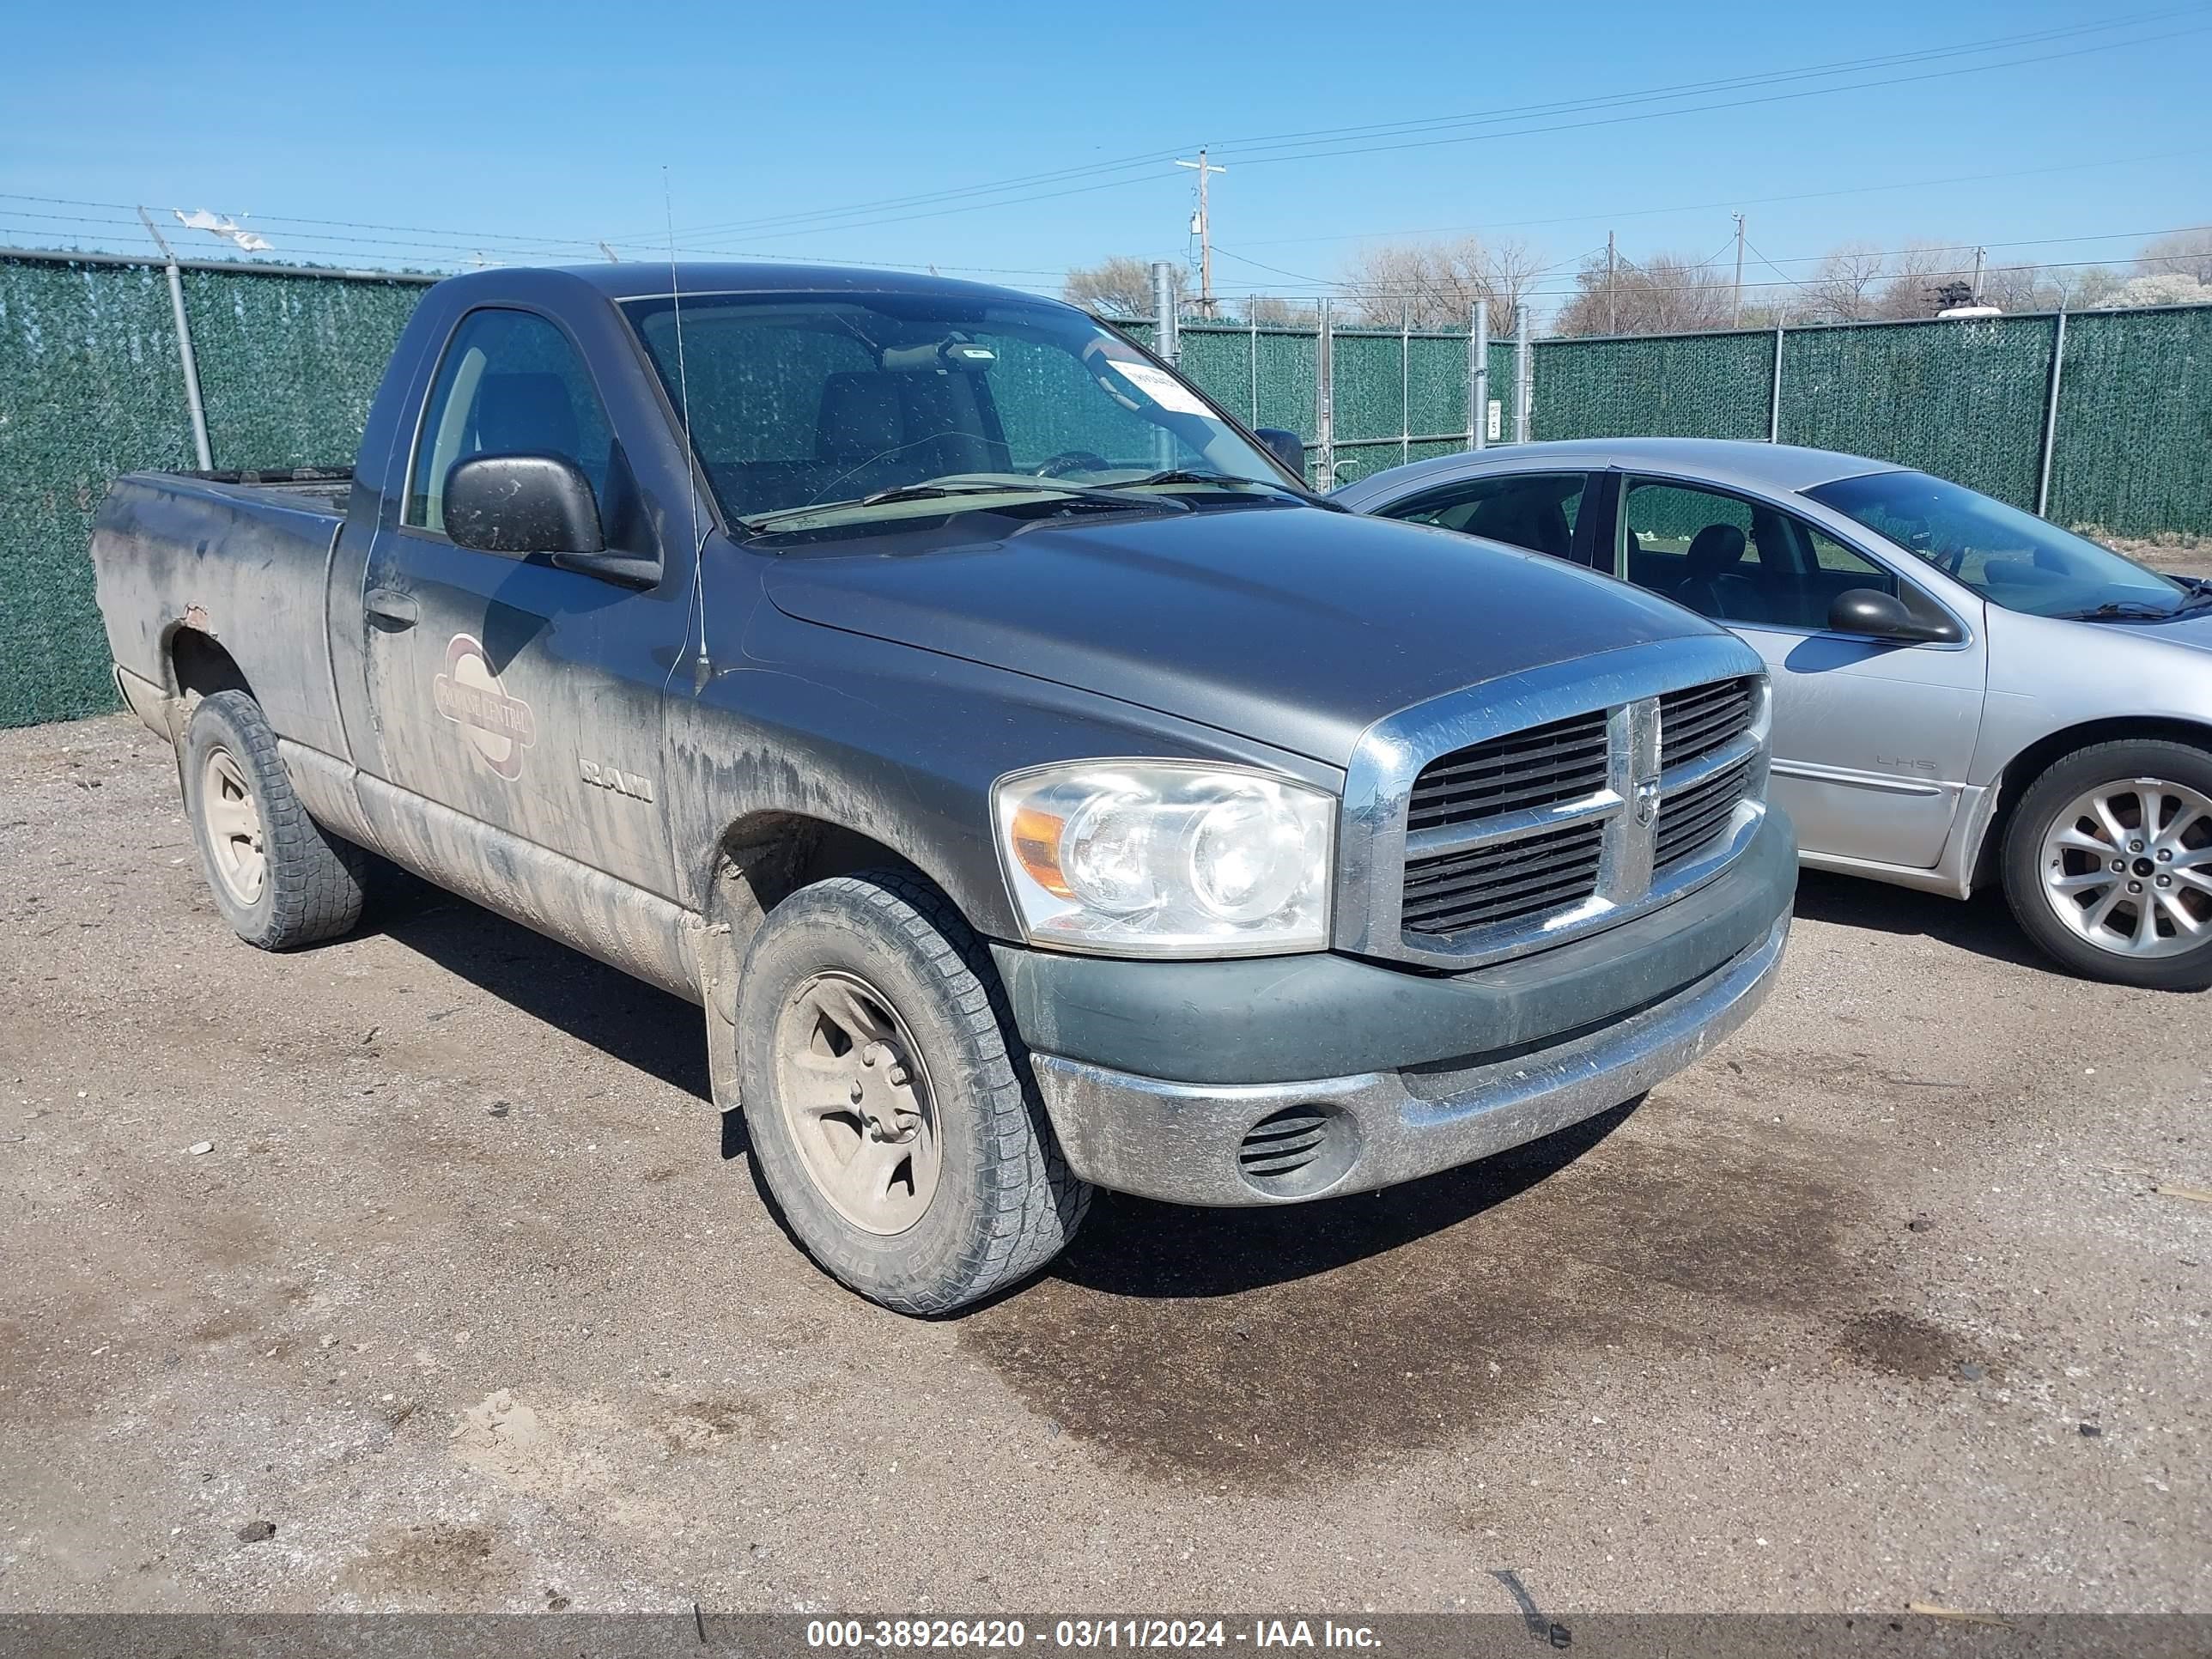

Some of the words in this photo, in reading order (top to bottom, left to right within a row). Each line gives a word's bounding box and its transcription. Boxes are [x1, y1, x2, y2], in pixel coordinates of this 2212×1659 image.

[1492, 422, 1497, 433] 5
[482, 697, 528, 732] CENTRAL
[1876, 755, 1937, 770] LHS
[579, 757, 653, 804] RAM
